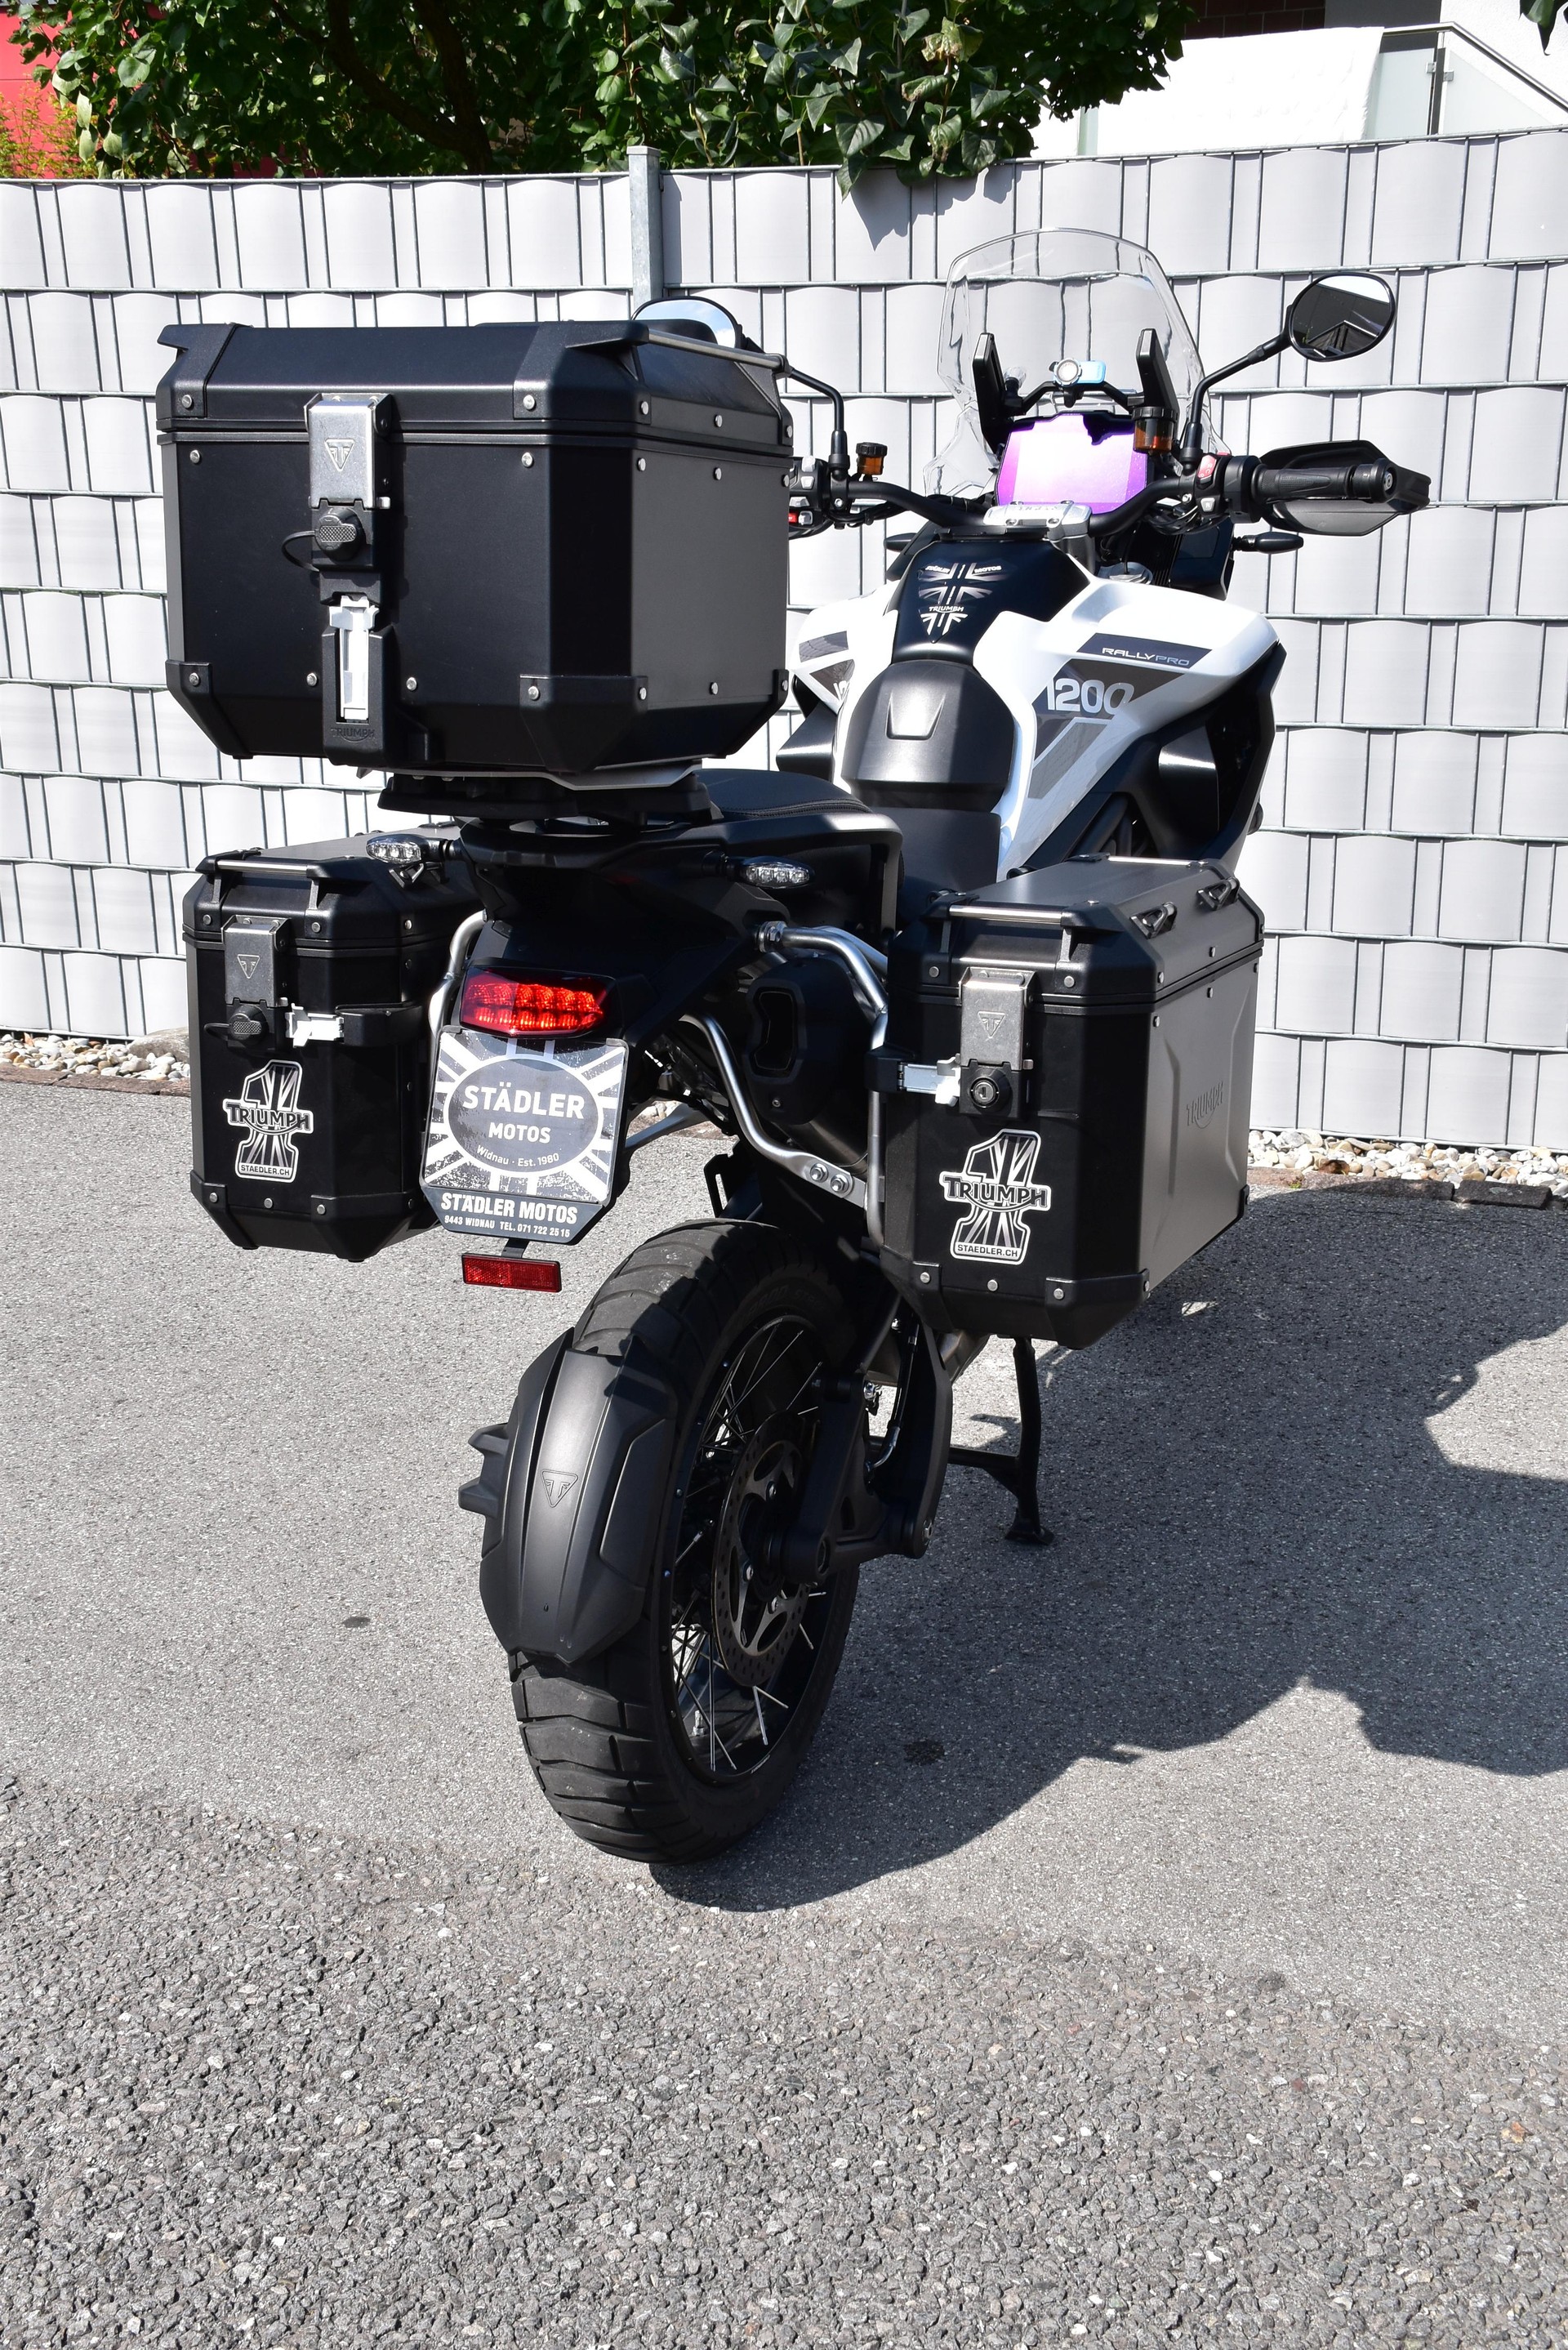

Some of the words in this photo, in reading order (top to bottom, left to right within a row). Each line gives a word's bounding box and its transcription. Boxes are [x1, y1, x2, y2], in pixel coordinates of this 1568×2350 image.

[1046, 677, 1135, 716] 1200
[462, 1081, 585, 1119] STÄDLER
[225, 1102, 311, 1134] TRIUMPH
[488, 1121, 551, 1144] MOTOS
[476, 1144, 509, 1165] Widnau
[517, 1157, 536, 1167] Est.
[537, 1153, 559, 1166] 1980
[240, 1164, 290, 1176] STAEDLER.CH
[943, 1175, 1048, 1212] TRIUMPH
[440, 1192, 516, 1218] STÄDLER
[519, 1201, 578, 1224] MOTOS
[444, 1215, 463, 1225] 9443
[465, 1217, 496, 1229] WIDNAU
[500, 1221, 516, 1232] TEL.
[517, 1223, 532, 1233] 071
[533, 1225, 548, 1235] 722
[957, 1243, 1018, 1257] STAEDLER.CH
